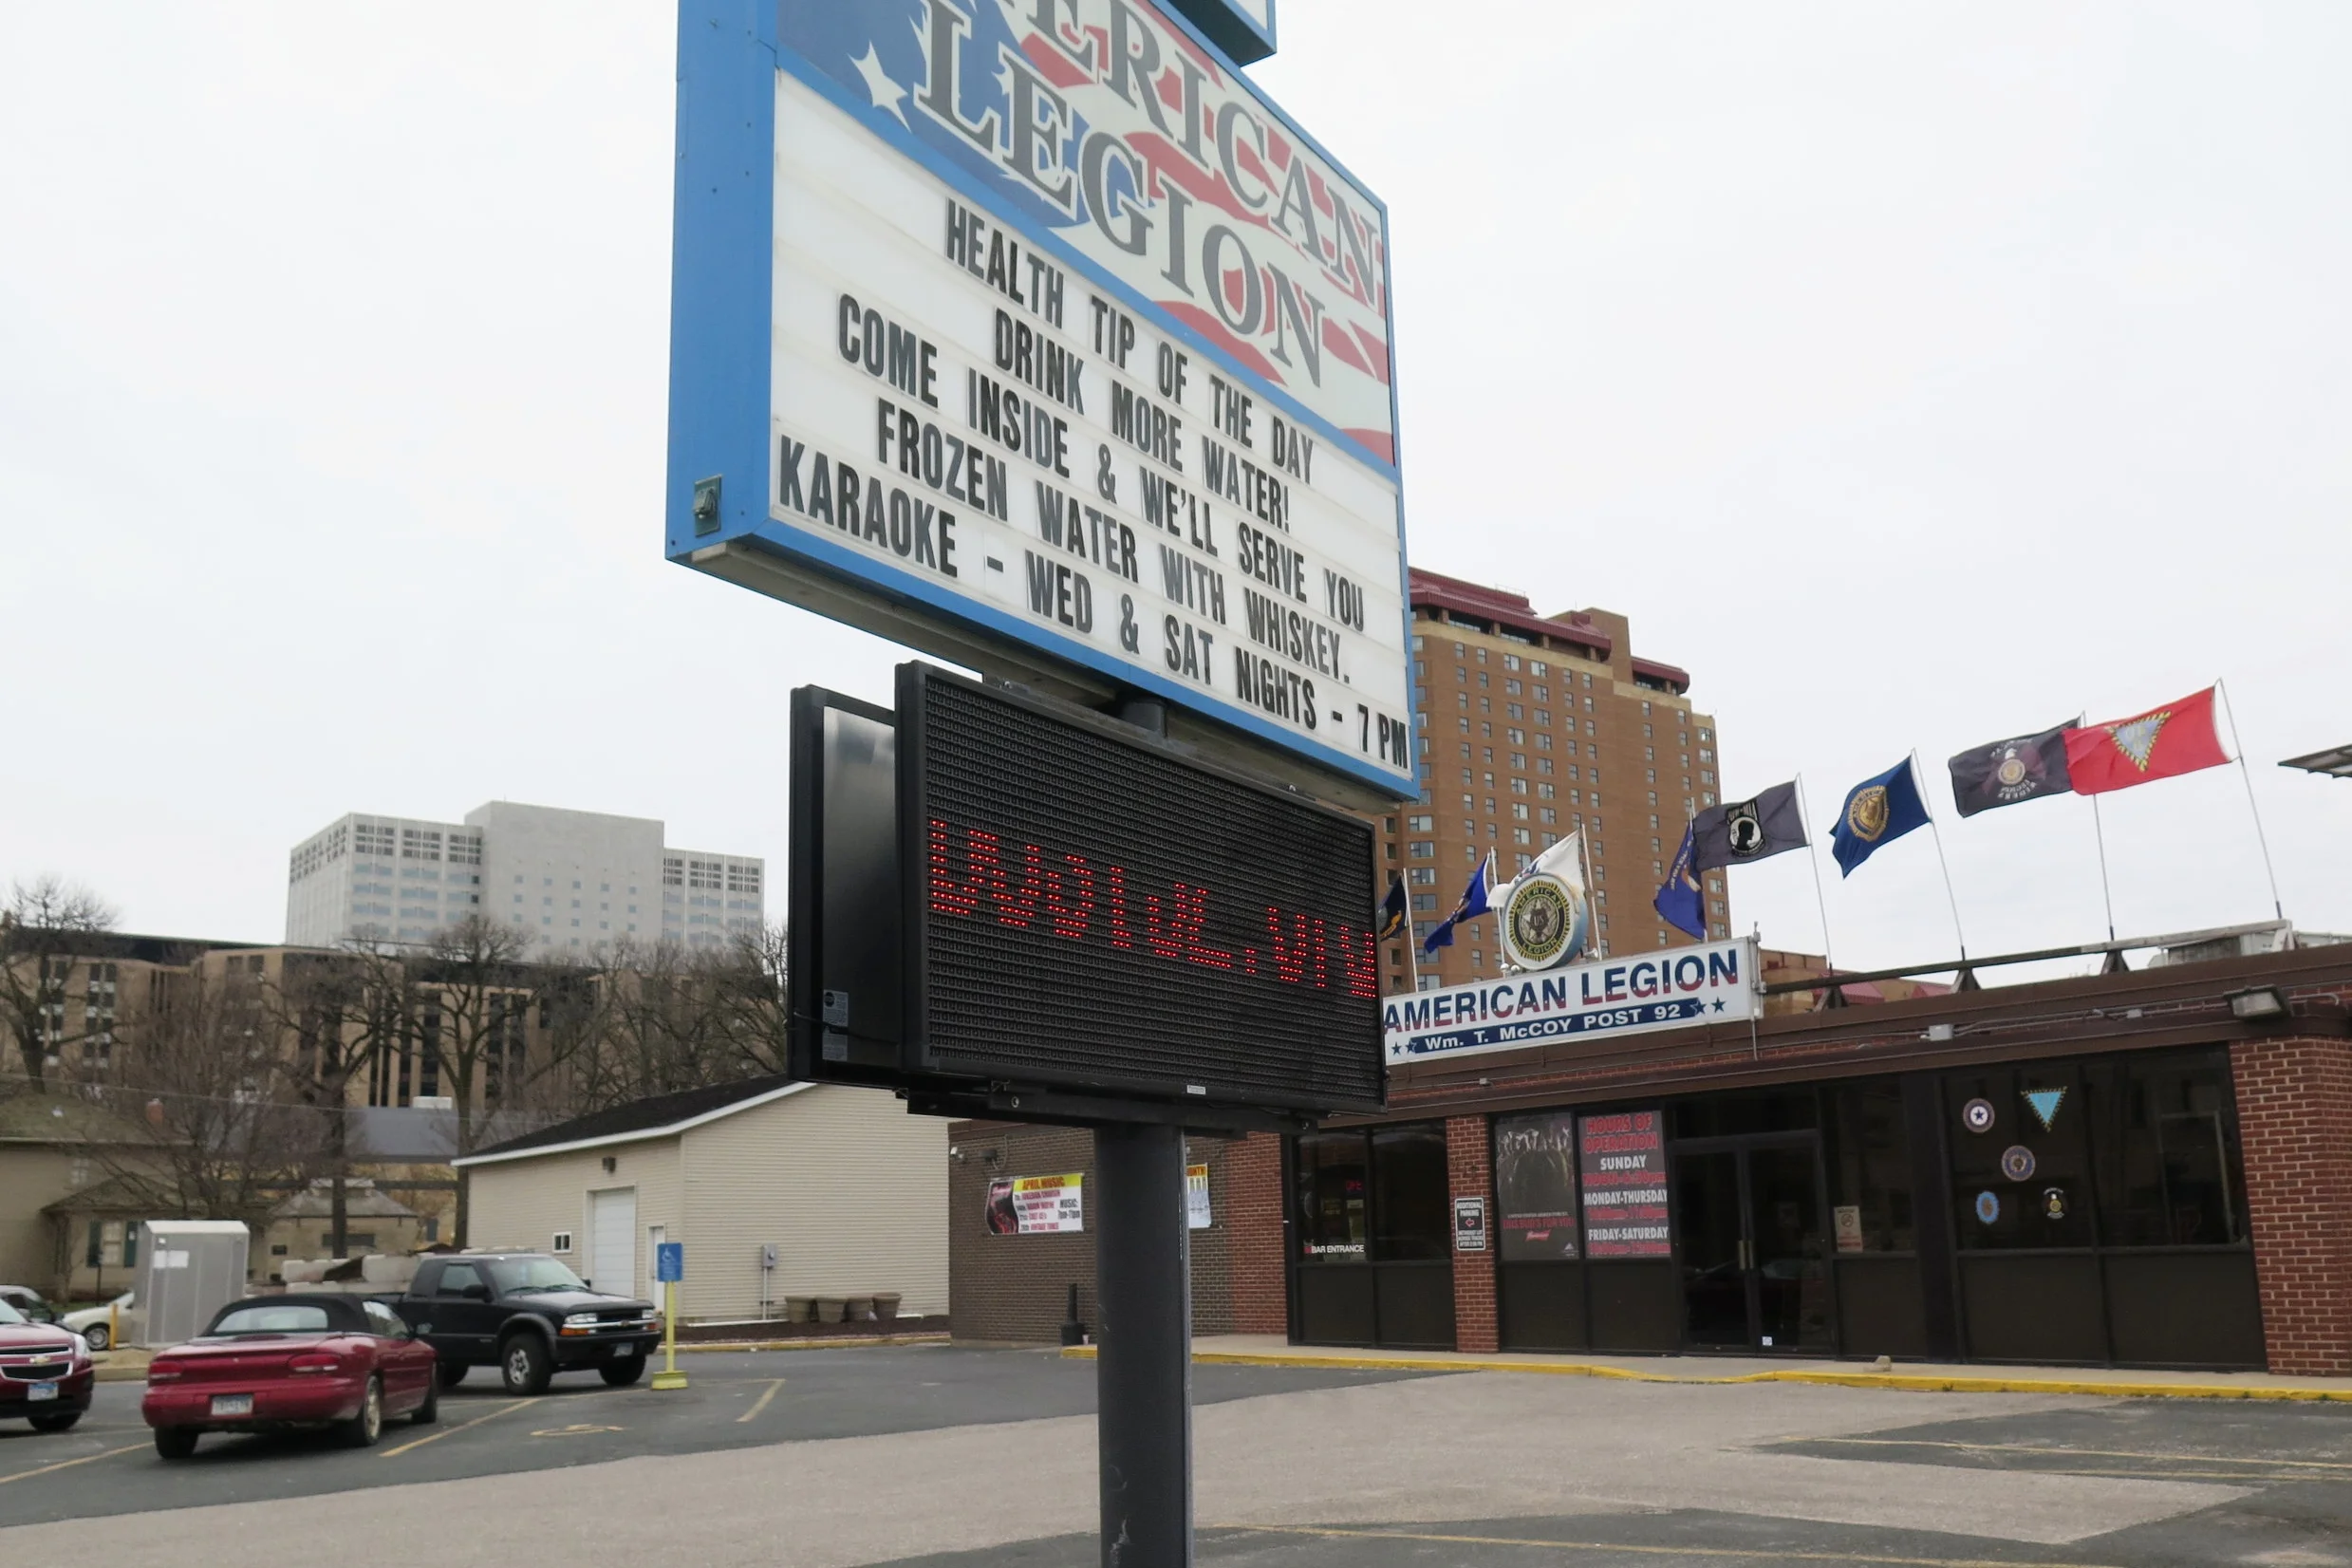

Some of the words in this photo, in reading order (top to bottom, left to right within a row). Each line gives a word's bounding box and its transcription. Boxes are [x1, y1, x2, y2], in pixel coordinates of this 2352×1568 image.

[1001, 0, 1378, 308] ERICAN
[918, 0, 1326, 388] LEGION
[945, 197, 1065, 329] HEALTH
[1091, 295, 1135, 370] TIP
[1158, 341, 1188, 405] OF
[1209, 374, 1253, 449] THE
[1273, 414, 1315, 486] DAY
[995, 307, 1085, 416] DRINK
[1111, 379, 1184, 473] MORE
[1202, 435, 1292, 534] WATER!
[839, 292, 939, 408] COME
[968, 366, 1071, 479] INSIDE
[1097, 442, 1118, 506] &
[1140, 465, 1219, 557] WE'LL
[1239, 521, 1308, 605] SERVE
[1325, 568, 1365, 633] YOU
[877, 396, 1009, 522] FROZEN
[1036, 479, 1140, 585] WATER
[1160, 543, 1227, 626] WITH
[1244, 587, 1350, 684] WHISKEY.
[778, 434, 959, 579] KARAOKE
[987, 554, 1005, 573] -
[1025, 550, 1093, 635] WED
[1119, 593, 1140, 656] &
[1165, 613, 1214, 686] SAT
[1235, 645, 1317, 731] NIGHTS
[1331, 710, 1343, 722] -
[1356, 703, 1369, 753] 7
[1376, 712, 1408, 770] PM
[1516, 887, 1563, 915] AMERICAN
[1521, 936, 1559, 955] LEGION
[1384, 976, 1567, 1036] AMERICAN
[1581, 948, 1739, 1006] LEGION
[1425, 1036, 1465, 1051] Wm.
[1473, 1030, 1489, 1044] T.
[1500, 1017, 1573, 1042] McCOY
[1583, 1007, 1643, 1030] POST
[1654, 1003, 1681, 1020] 92
[1583, 1131, 1658, 1154] OPERATION
[1587, 1113, 1632, 1135] HOURS
[1635, 1112, 1652, 1131] OF
[1599, 1154, 1647, 1170] SUNDAY
[1041, 1176, 1065, 1189] MUSIC
[1584, 1188, 1668, 1206] MONDAY-THURSDAY
[1311, 1245, 1326, 1254] BAR
[1327, 1244, 1365, 1254] ENTRANCE
[1588, 1225, 1669, 1241] FRIDAY-SATURDAY
